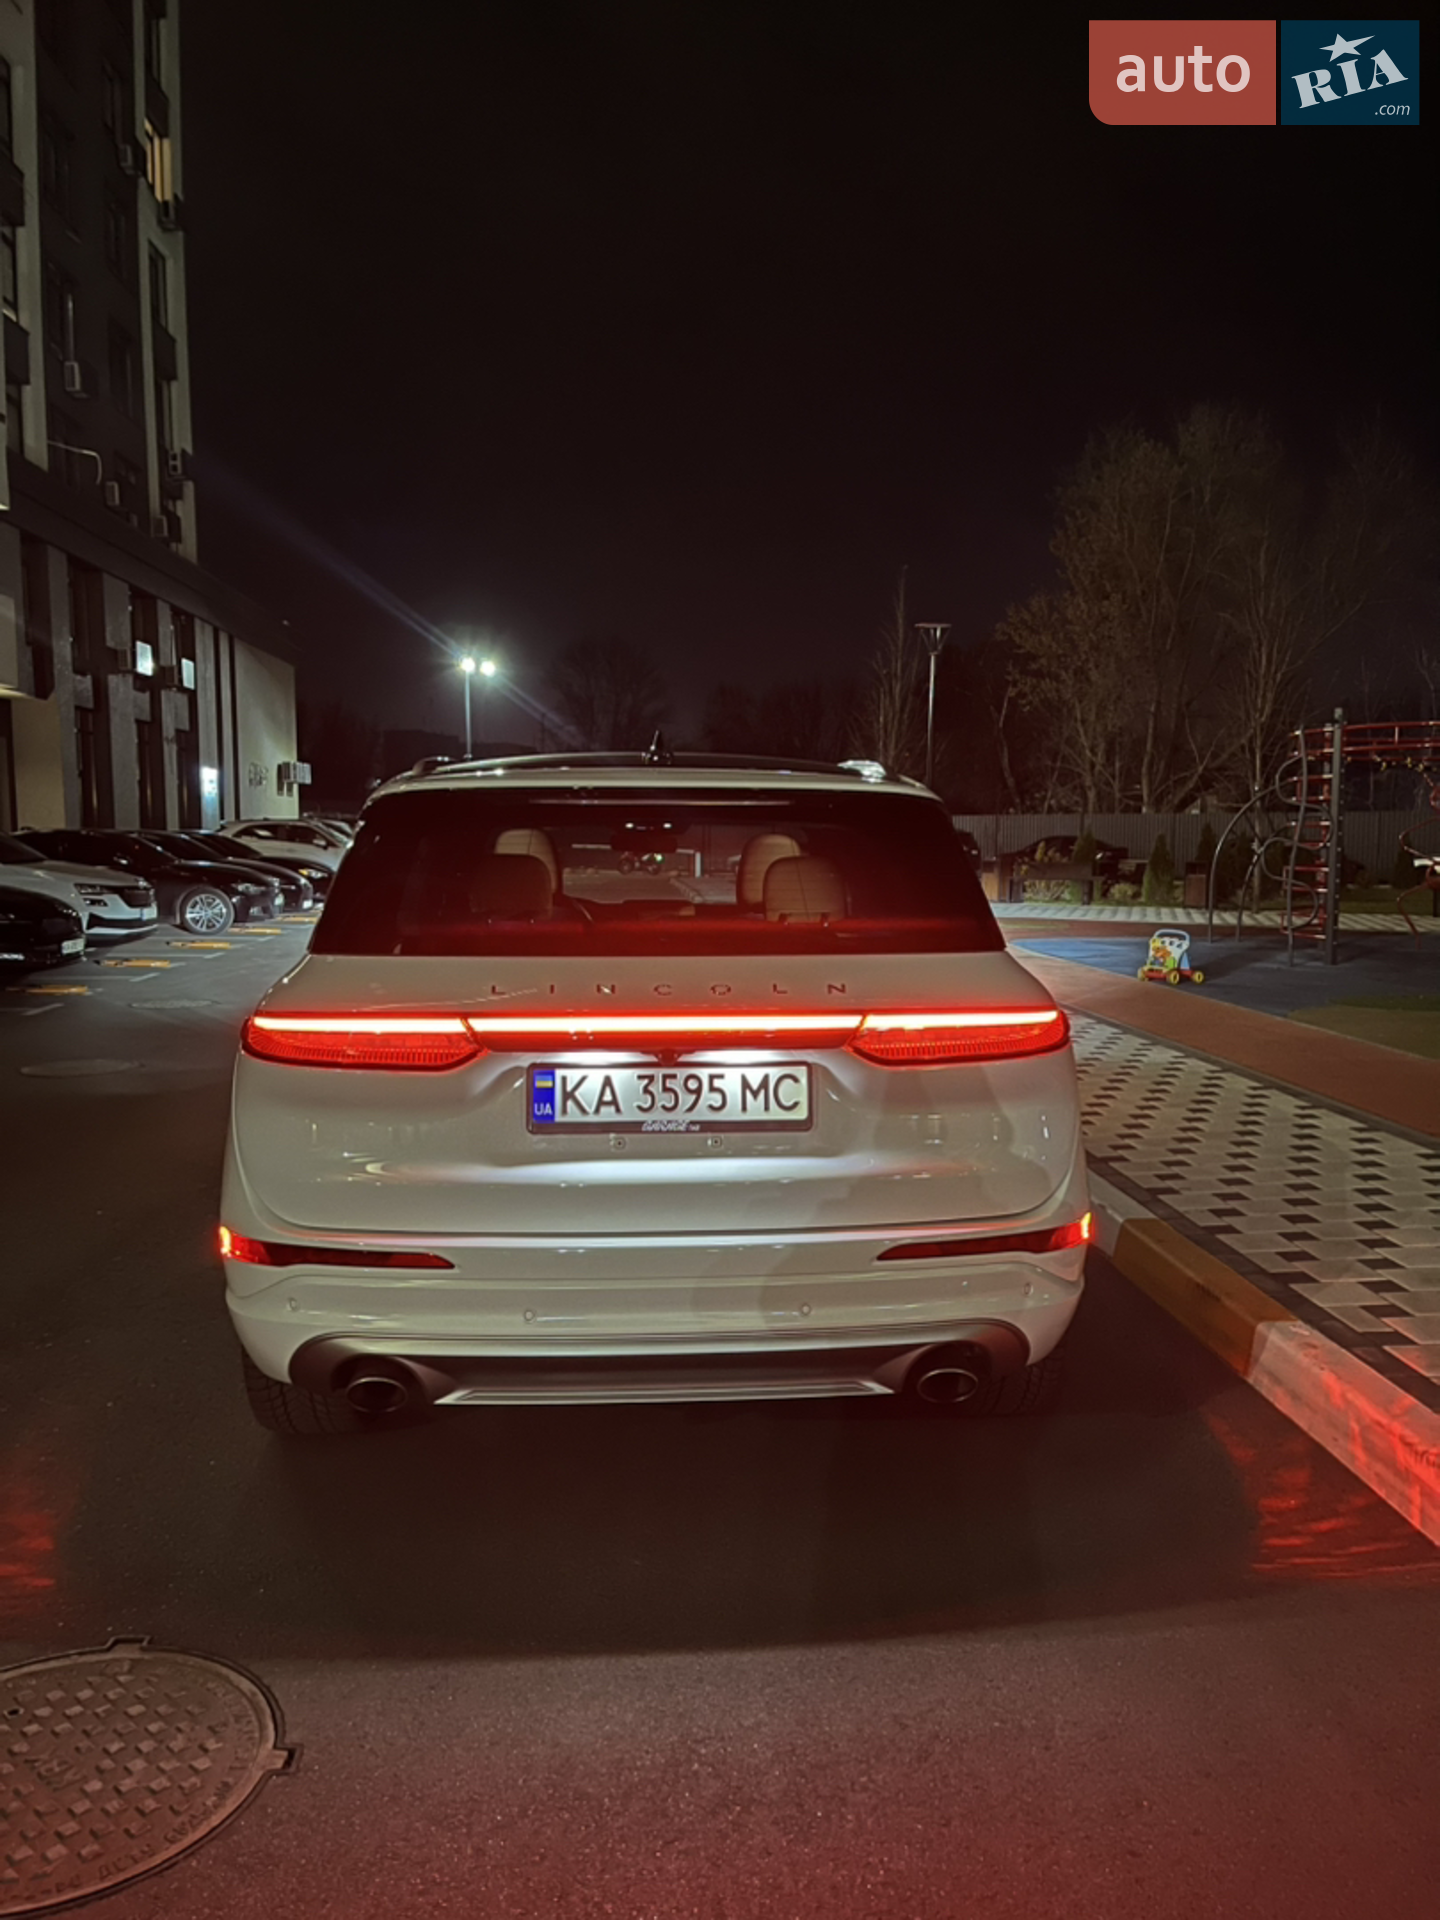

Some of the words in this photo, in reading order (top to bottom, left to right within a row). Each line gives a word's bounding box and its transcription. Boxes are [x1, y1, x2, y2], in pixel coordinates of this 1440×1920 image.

[491, 983, 846, 996] LINCOLN
[561, 1075, 623, 1116] KA
[636, 1073, 728, 1114] 3595
[741, 1073, 801, 1113] MC
[534, 1103, 553, 1116] UA
